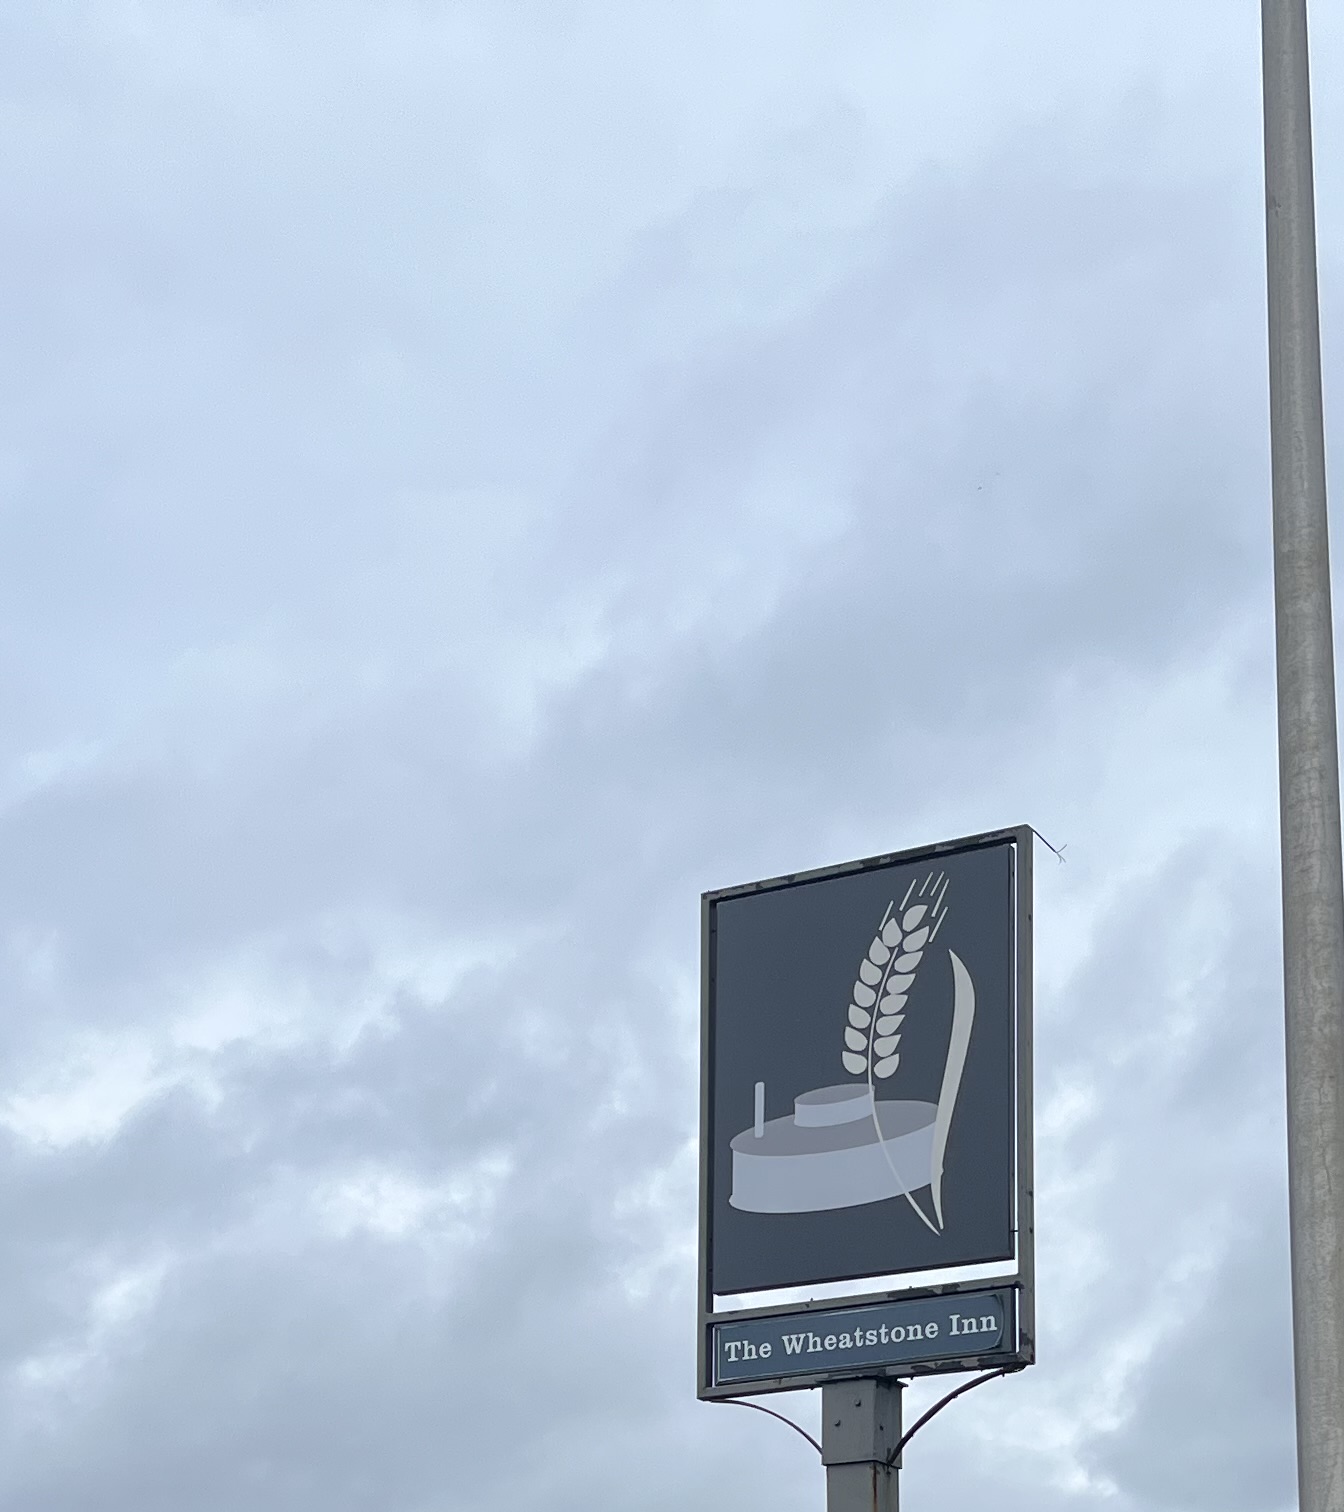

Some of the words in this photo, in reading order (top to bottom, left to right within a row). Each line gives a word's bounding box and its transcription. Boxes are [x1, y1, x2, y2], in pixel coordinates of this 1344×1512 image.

[724, 1339, 772, 1363] The
[782, 1321, 939, 1356] Wheatstone
[949, 1313, 998, 1336] Inn
